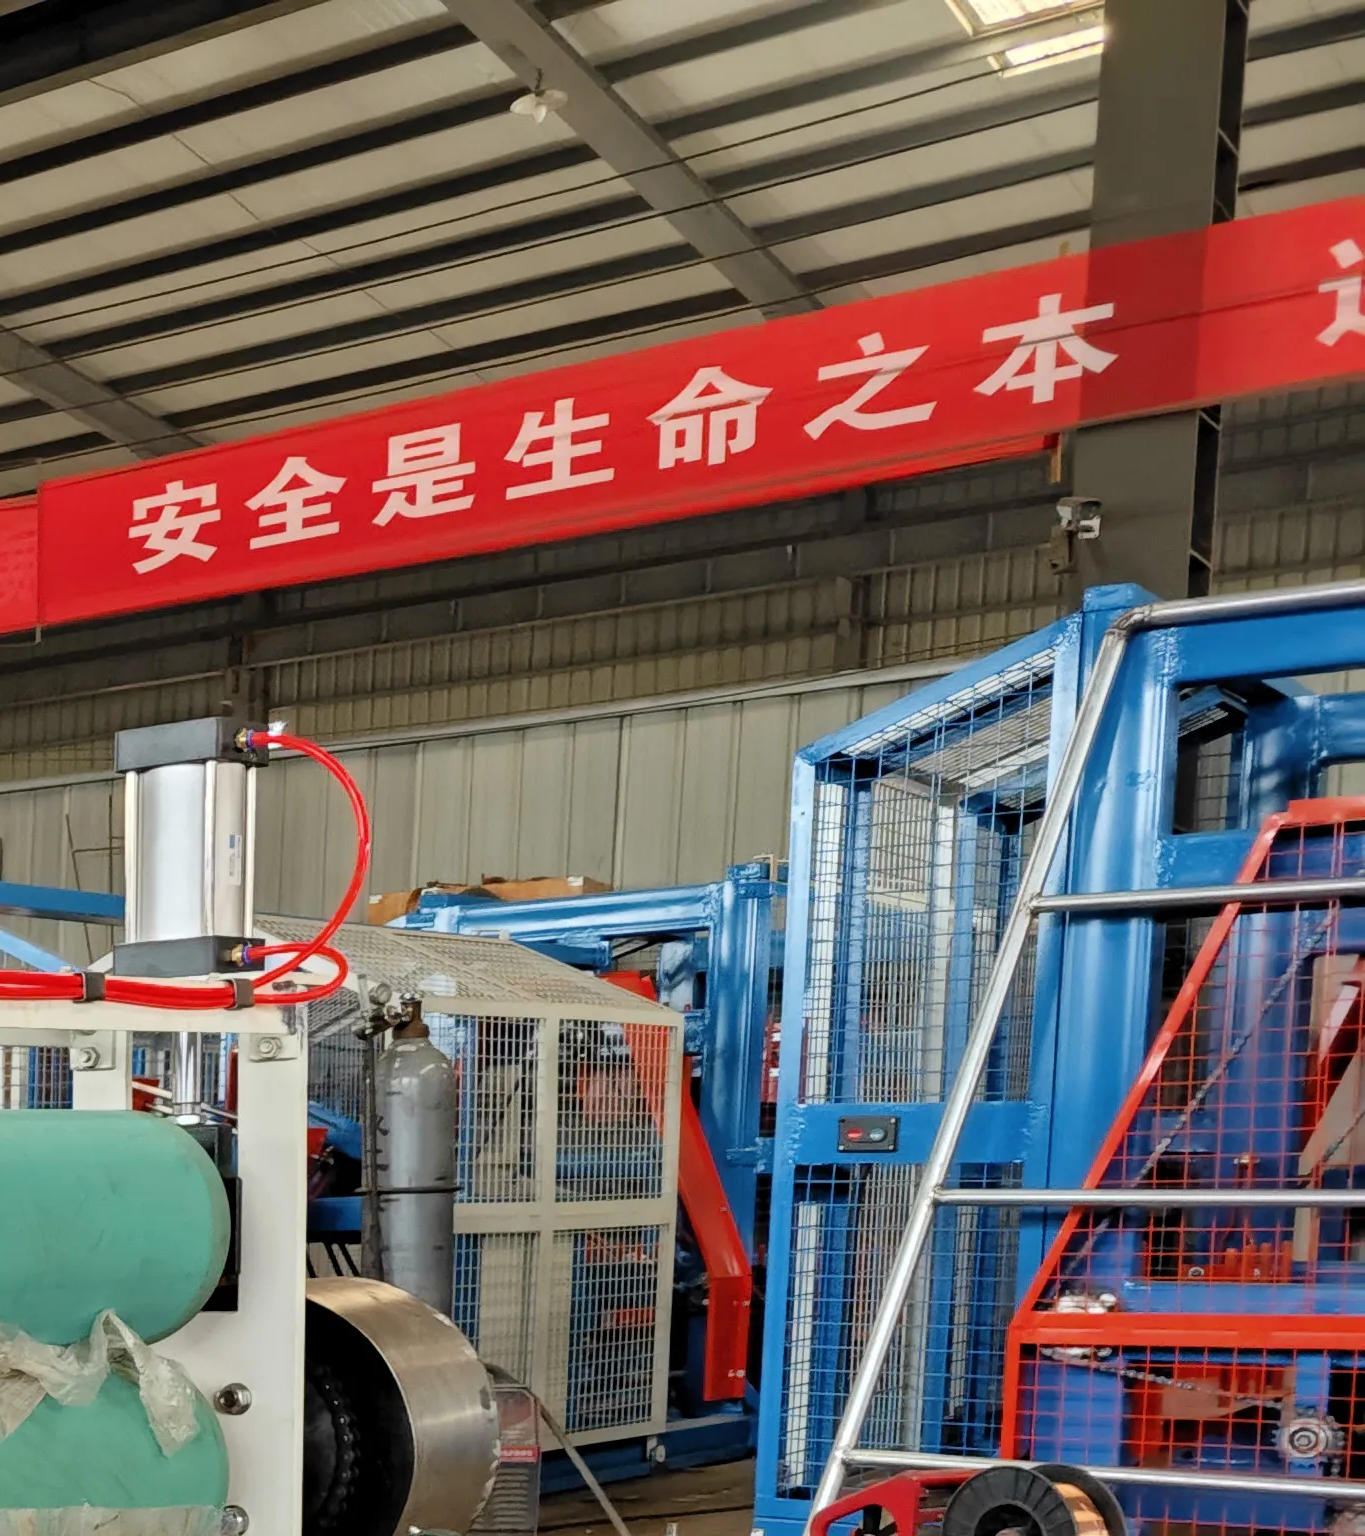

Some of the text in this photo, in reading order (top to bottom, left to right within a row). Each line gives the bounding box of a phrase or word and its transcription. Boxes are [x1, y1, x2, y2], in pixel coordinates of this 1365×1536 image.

[126, 293, 1118, 575] 安全是生命之本
